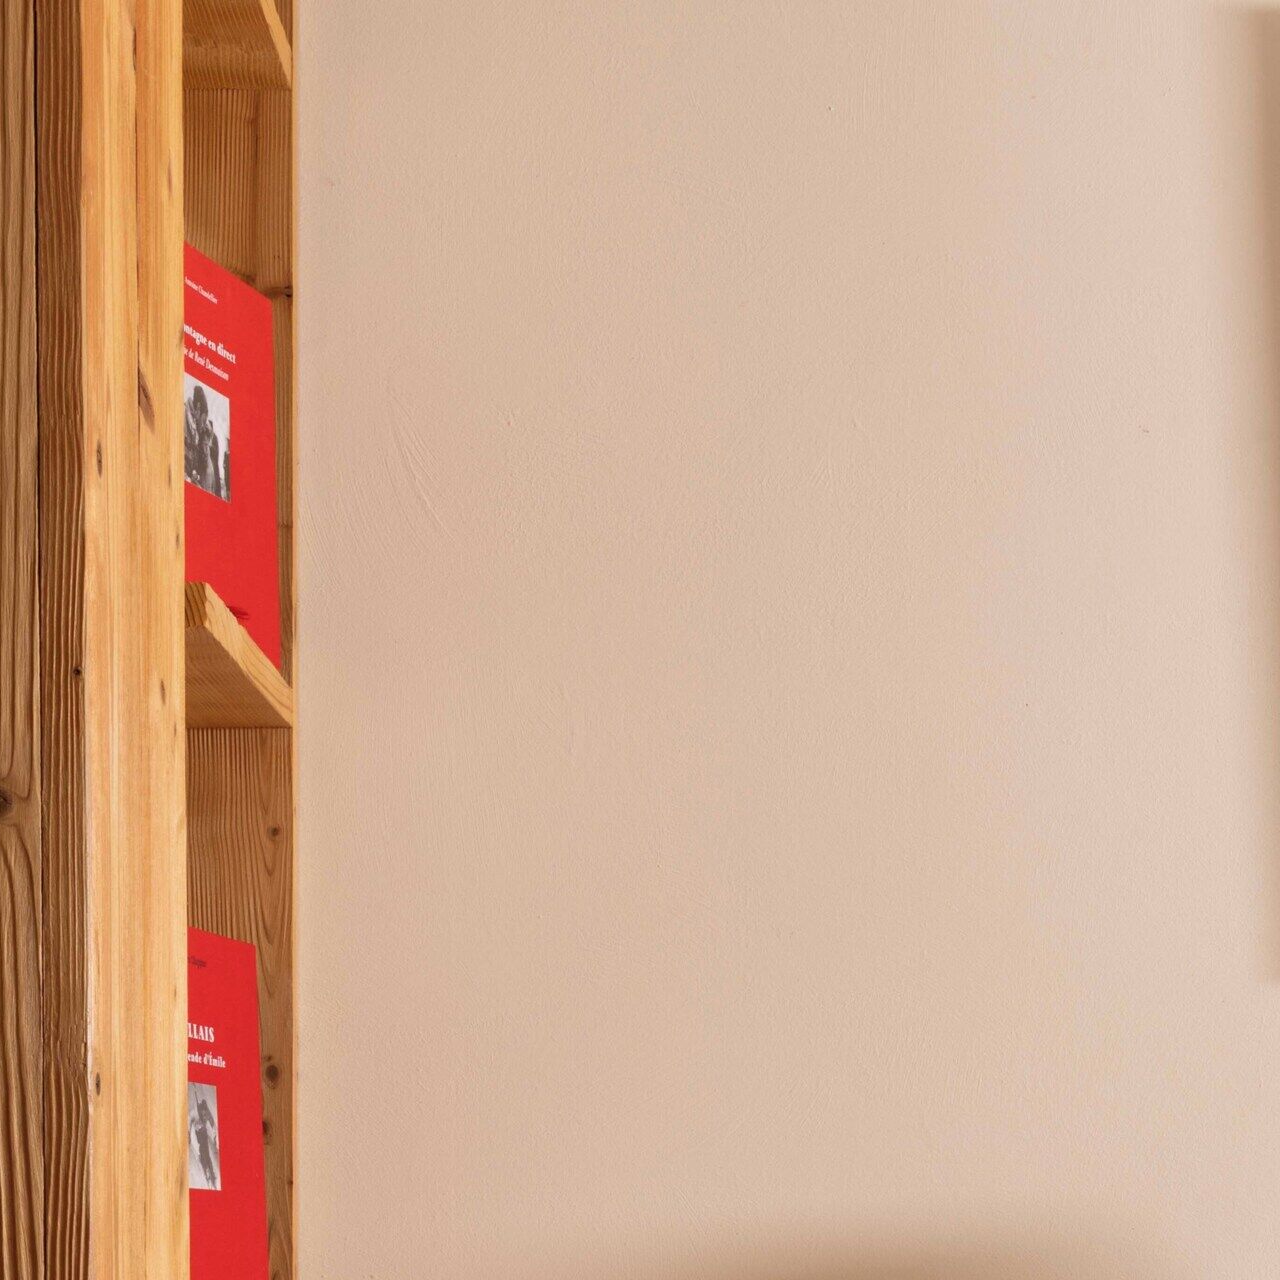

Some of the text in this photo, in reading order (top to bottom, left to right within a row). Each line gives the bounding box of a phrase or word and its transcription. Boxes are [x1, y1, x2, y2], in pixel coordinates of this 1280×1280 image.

[217, 341, 236, 364] direct
[187, 1021, 215, 1043] LLAIS
[187, 1051, 202, 1065] ende
